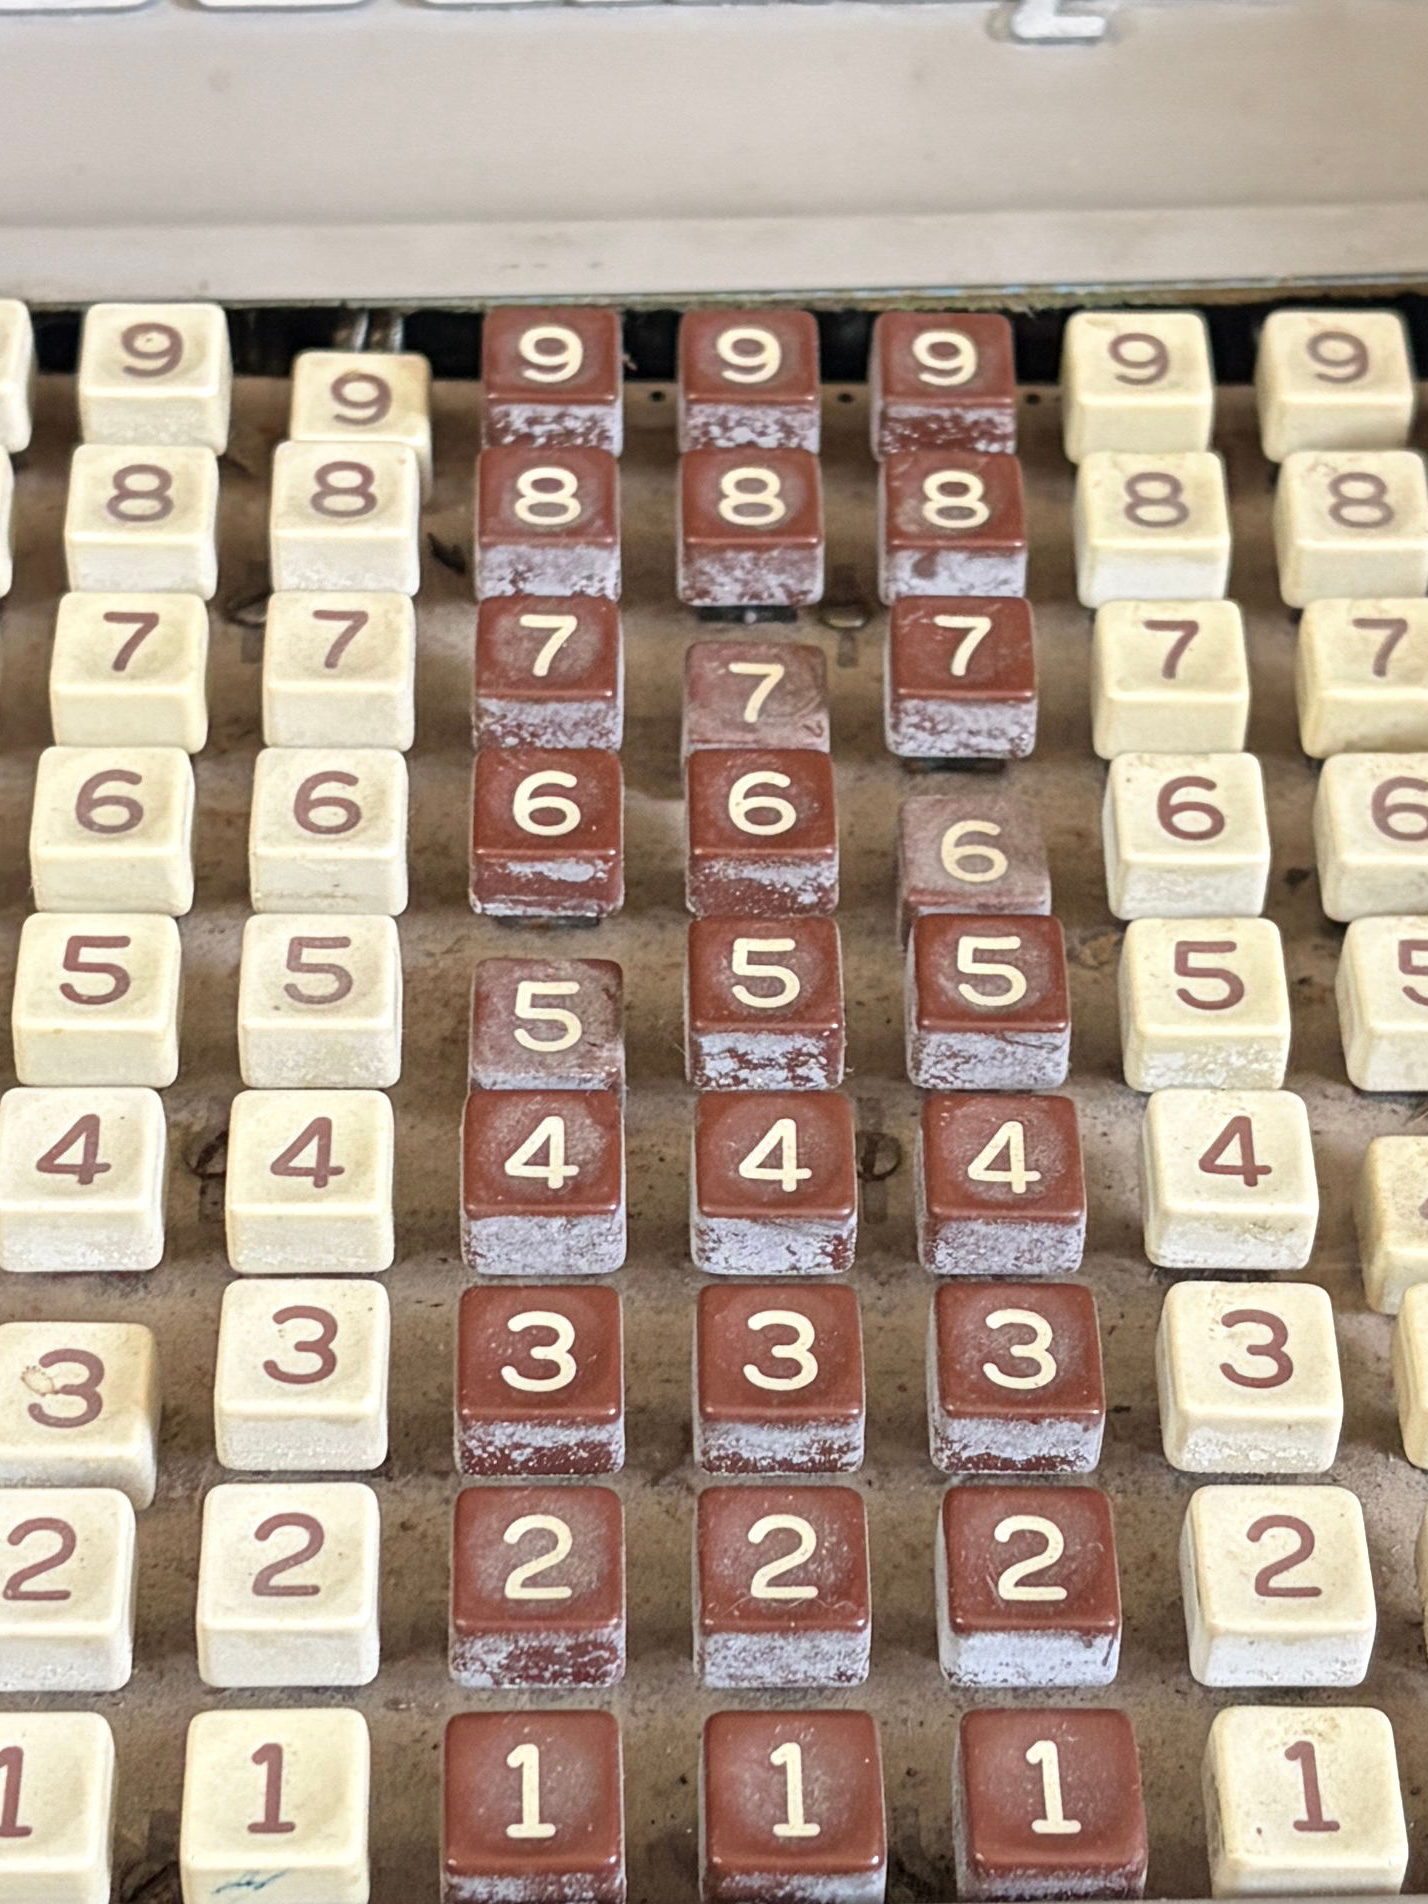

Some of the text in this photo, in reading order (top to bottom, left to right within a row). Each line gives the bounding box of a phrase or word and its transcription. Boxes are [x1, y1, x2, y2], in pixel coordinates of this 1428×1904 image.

[121, 322, 183, 379] 9
[518, 325, 583, 383] 9
[716, 327, 781, 383] 9
[912, 330, 977, 386] 9
[1108, 332, 1171, 386] 9
[1307, 330, 1370, 385] 9
[330, 372, 393, 427] 9
[106, 464, 174, 523] 8
[310, 461, 378, 519] 8
[514, 466, 581, 525] 8
[718, 467, 786, 525] 8
[922, 470, 990, 528] 8
[1124, 471, 1190, 529] 8
[1328, 471, 1396, 530] 8
[103, 611, 160, 673] 7
[312, 609, 369, 670] 7
[519, 614, 578, 676] 7
[933, 614, 992, 676] 7
[1144, 619, 1200, 680] 7
[1352, 617, 1409, 678] 7
[728, 662, 785, 723] 7
[75, 769, 144, 835] 6
[293, 770, 363, 836] 6
[512, 770, 581, 836] 6
[728, 770, 797, 835] 6
[1157, 775, 1226, 842] 6
[941, 820, 1008, 882] 6
[59, 935, 132, 1006] 5
[283, 936, 354, 1006] 5
[731, 938, 800, 1008] 5
[957, 936, 1027, 1007] 5
[1174, 940, 1246, 1011] 5
[514, 981, 582, 1052] 5
[35, 1113, 112, 1186] 4
[270, 1116, 346, 1189] 4
[504, 1116, 579, 1189] 4
[738, 1118, 812, 1192] 4
[967, 1121, 1041, 1194] 4
[1198, 1115, 1273, 1188] 4
[263, 1305, 338, 1385] 3
[501, 1310, 577, 1392] 3
[743, 1310, 818, 1391] 3
[983, 1308, 1057, 1389] 3
[1219, 1309, 1294, 1390] 3
[27, 1348, 105, 1429] 3
[2, 1517, 77, 1602] 2
[251, 1512, 325, 1598] 2
[503, 1514, 573, 1599] 2
[747, 1514, 818, 1599] 2
[994, 1515, 1067, 1601] 2
[1246, 1514, 1323, 1599] 2
[247, 1743, 296, 1835] 1
[506, 1743, 556, 1838] 1
[770, 1742, 820, 1837] 1
[1025, 1740, 1081, 1834] 1
[1284, 1740, 1341, 1833] 1
